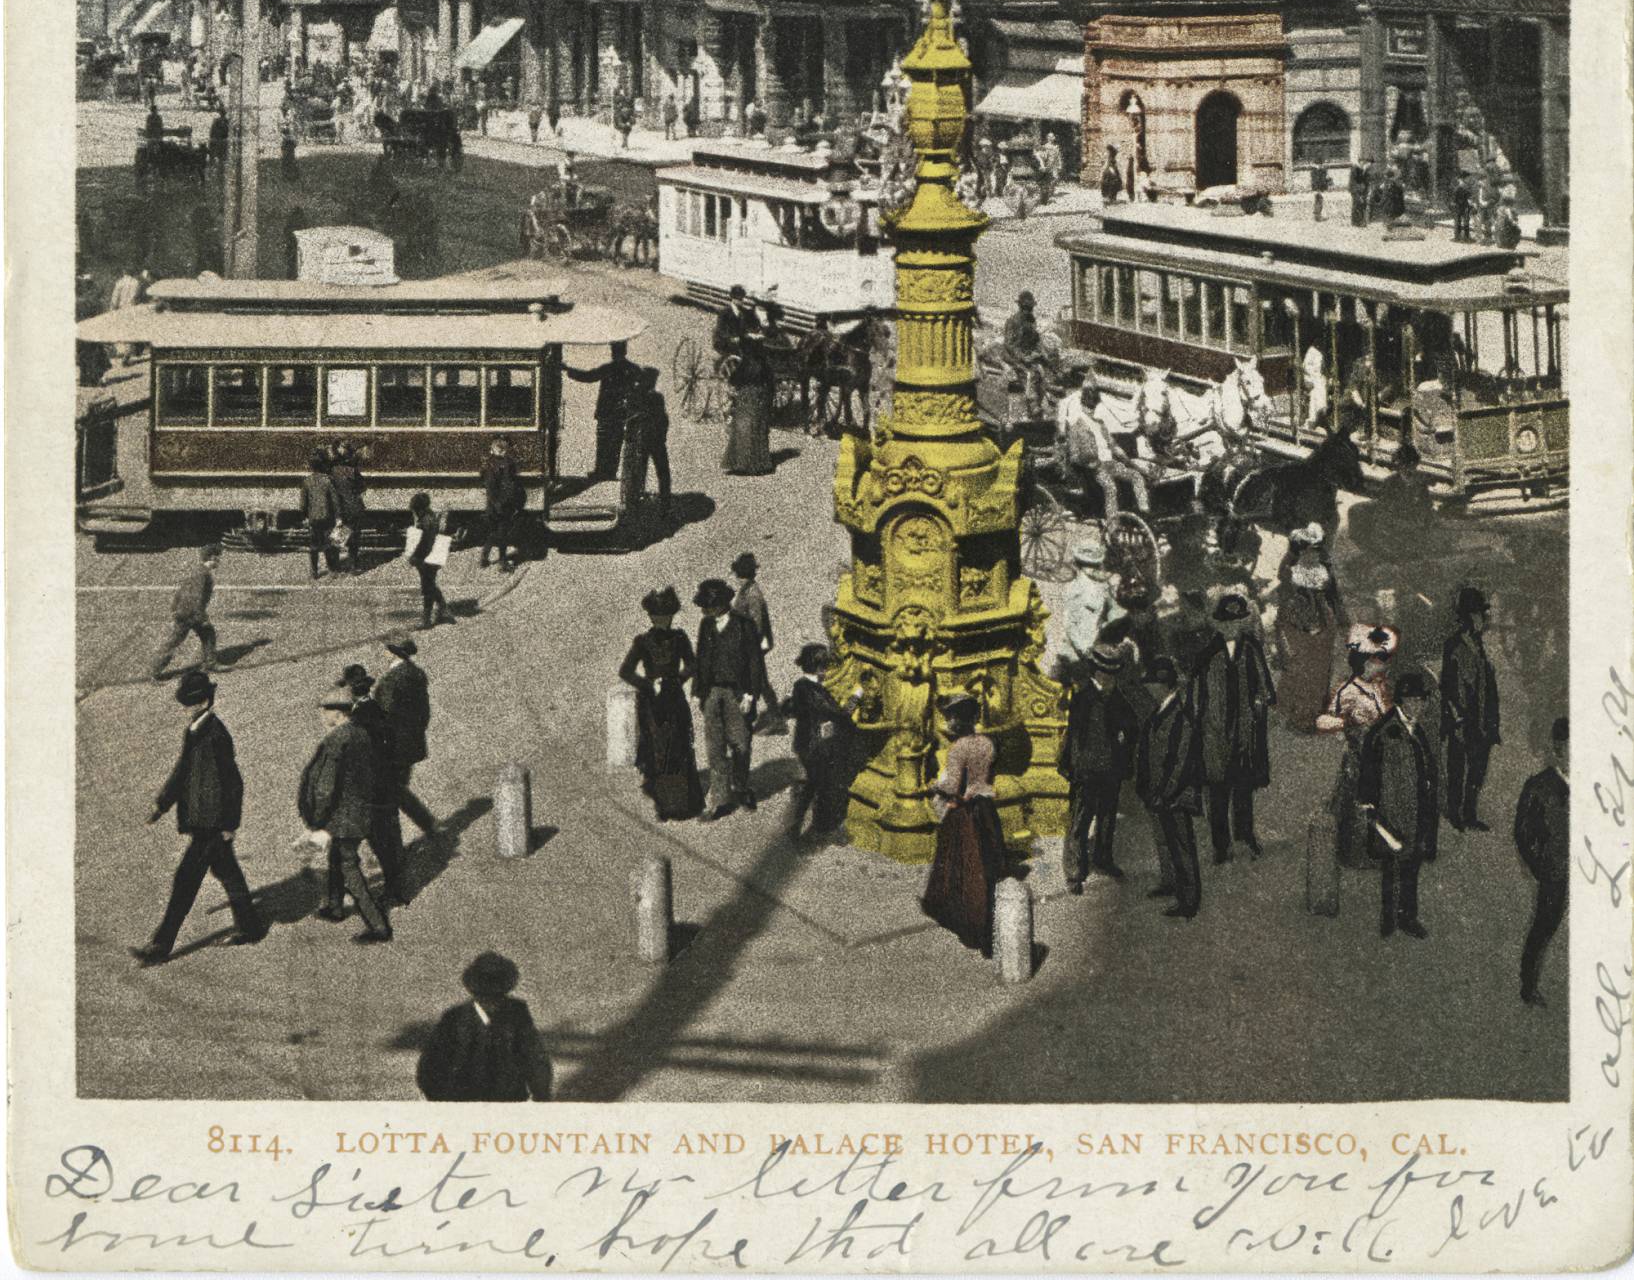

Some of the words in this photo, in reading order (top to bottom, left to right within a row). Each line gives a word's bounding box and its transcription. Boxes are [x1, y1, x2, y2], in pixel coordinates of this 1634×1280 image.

[45, 1145, 240, 1203] Dear
[704, 1139, 951, 1201] letter
[1369, 1152, 1497, 1220] for
[578, 1190, 748, 1272] hope
